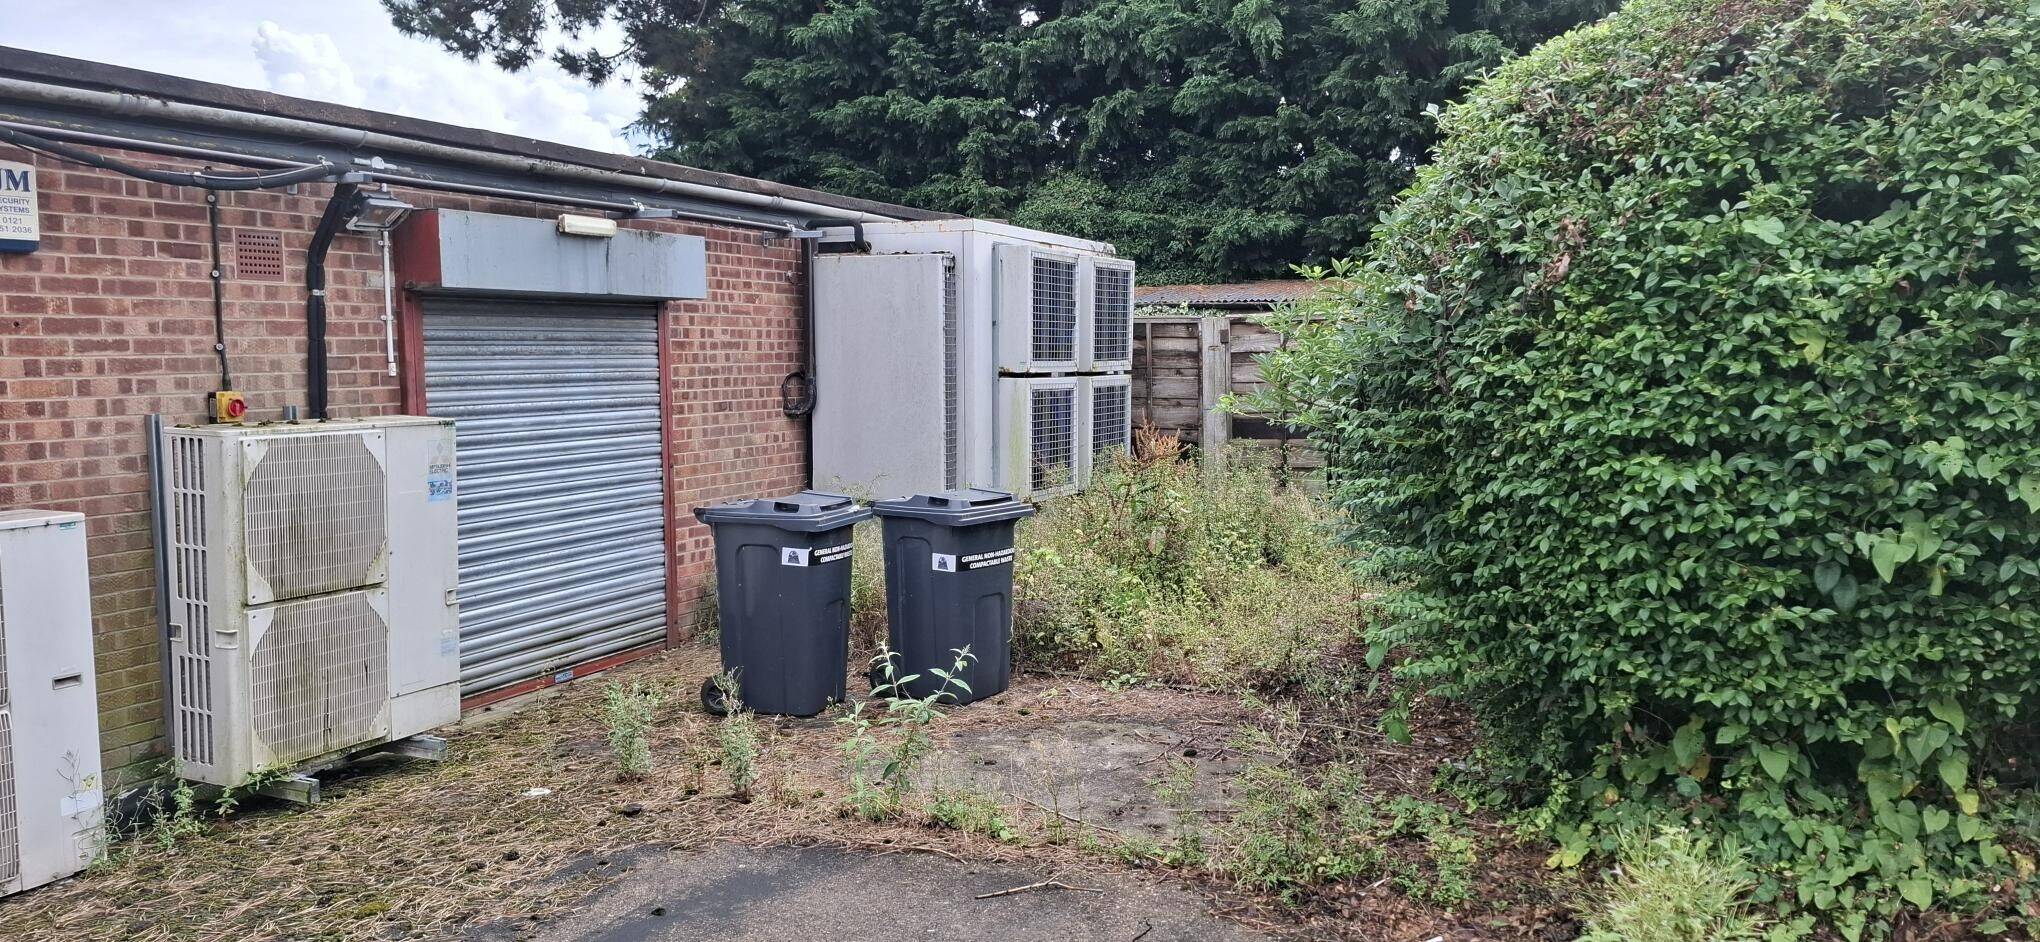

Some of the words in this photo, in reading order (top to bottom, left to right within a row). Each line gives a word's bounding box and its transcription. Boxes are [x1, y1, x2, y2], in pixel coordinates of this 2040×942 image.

[0, 168, 31, 192] M
[3, 216, 22, 224] 0121
[961, 553, 983, 562] GENERAL
